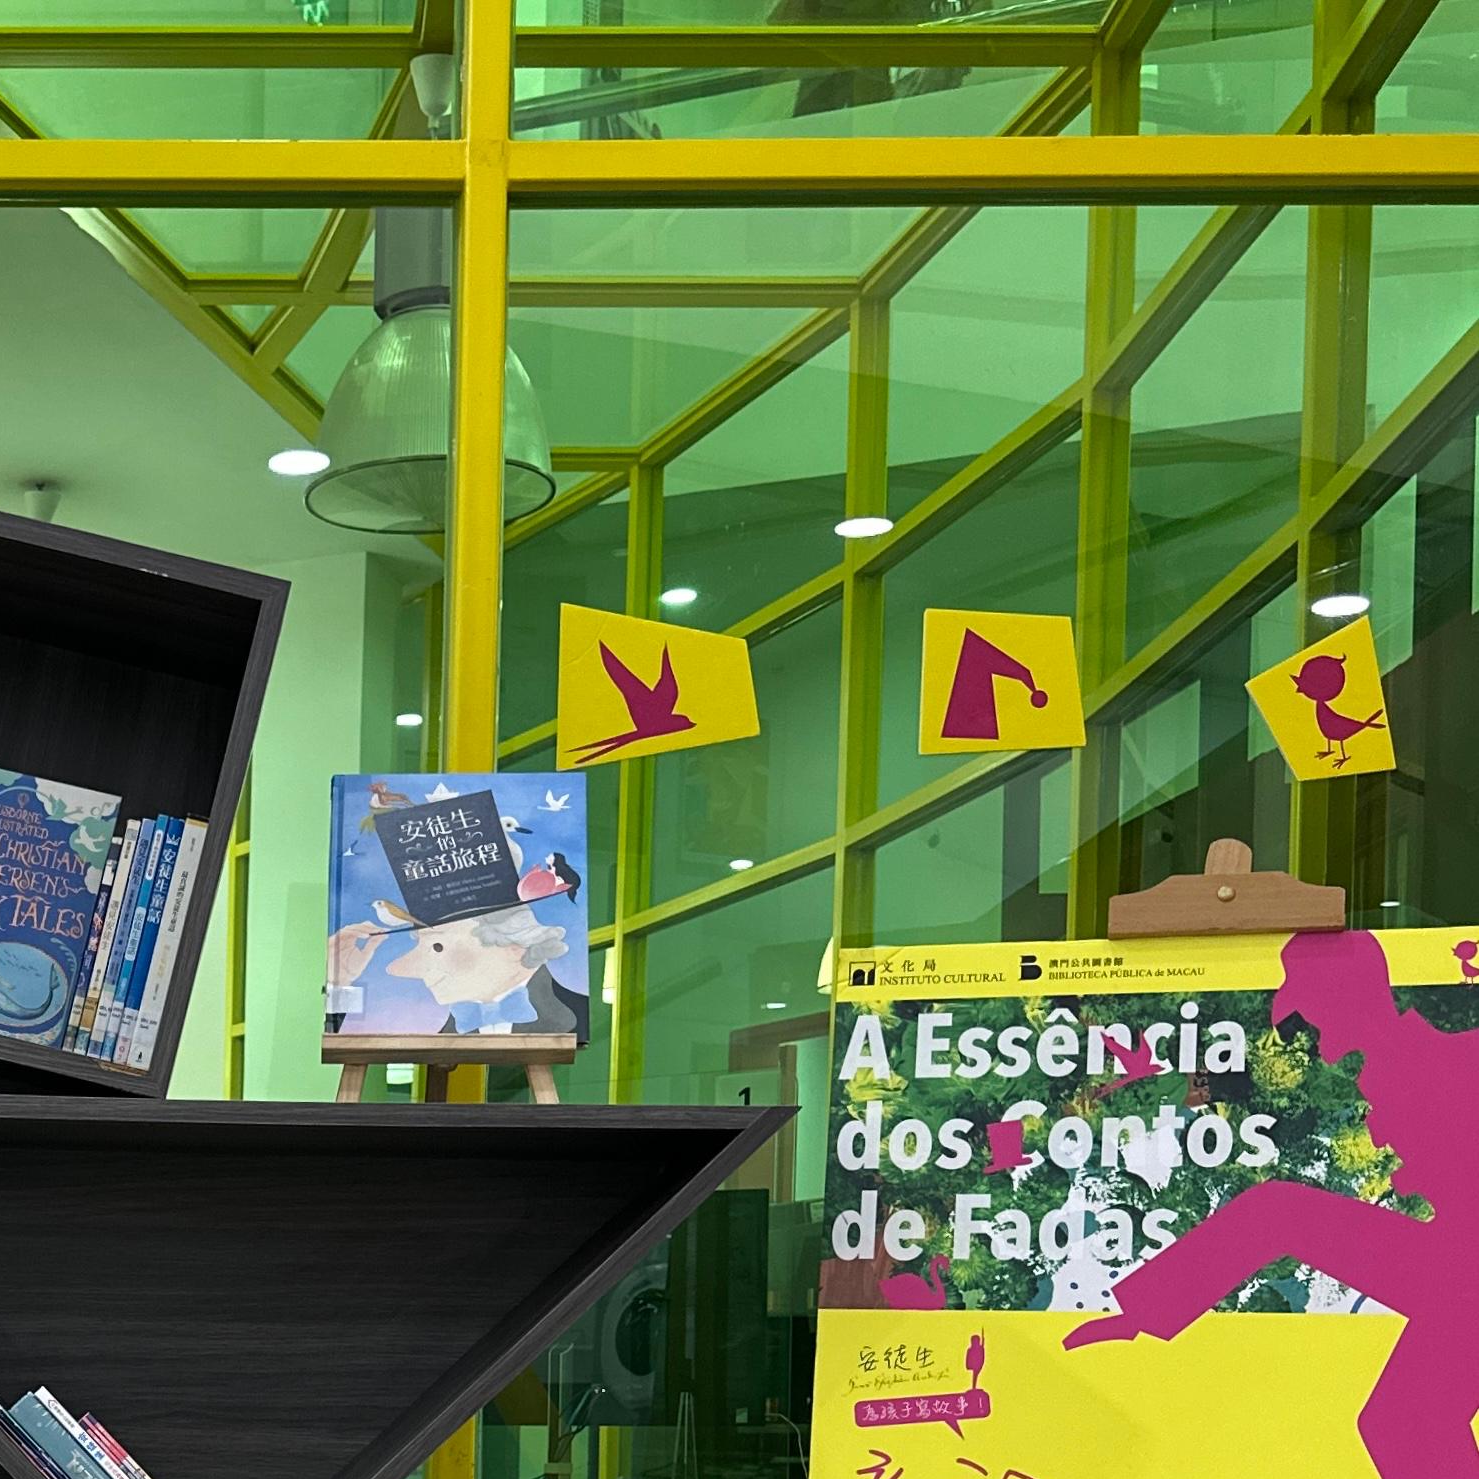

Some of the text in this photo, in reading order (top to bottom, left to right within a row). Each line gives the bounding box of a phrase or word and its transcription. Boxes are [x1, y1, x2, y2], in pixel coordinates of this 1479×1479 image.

[398, 808, 481, 844] 安徒生
[436, 836, 457, 850] 的
[401, 842, 503, 881] 童話旅程
[9, 894, 86, 939] TALES
[879, 971, 1007, 987] INSTITUTO CULTURAL
[881, 958, 937, 974] 文化局
[1048, 956, 1124, 970] 澳門公共圖書館
[1048, 966, 1206, 981] BIBLIOTECA PÚBLICA de MACAU
[838, 1001, 1246, 1081] A Essência
[837, 1100, 1278, 1171] dos Contos
[831, 1190, 1179, 1262] de Fadas
[858, 1344, 935, 1372] 安徒生
